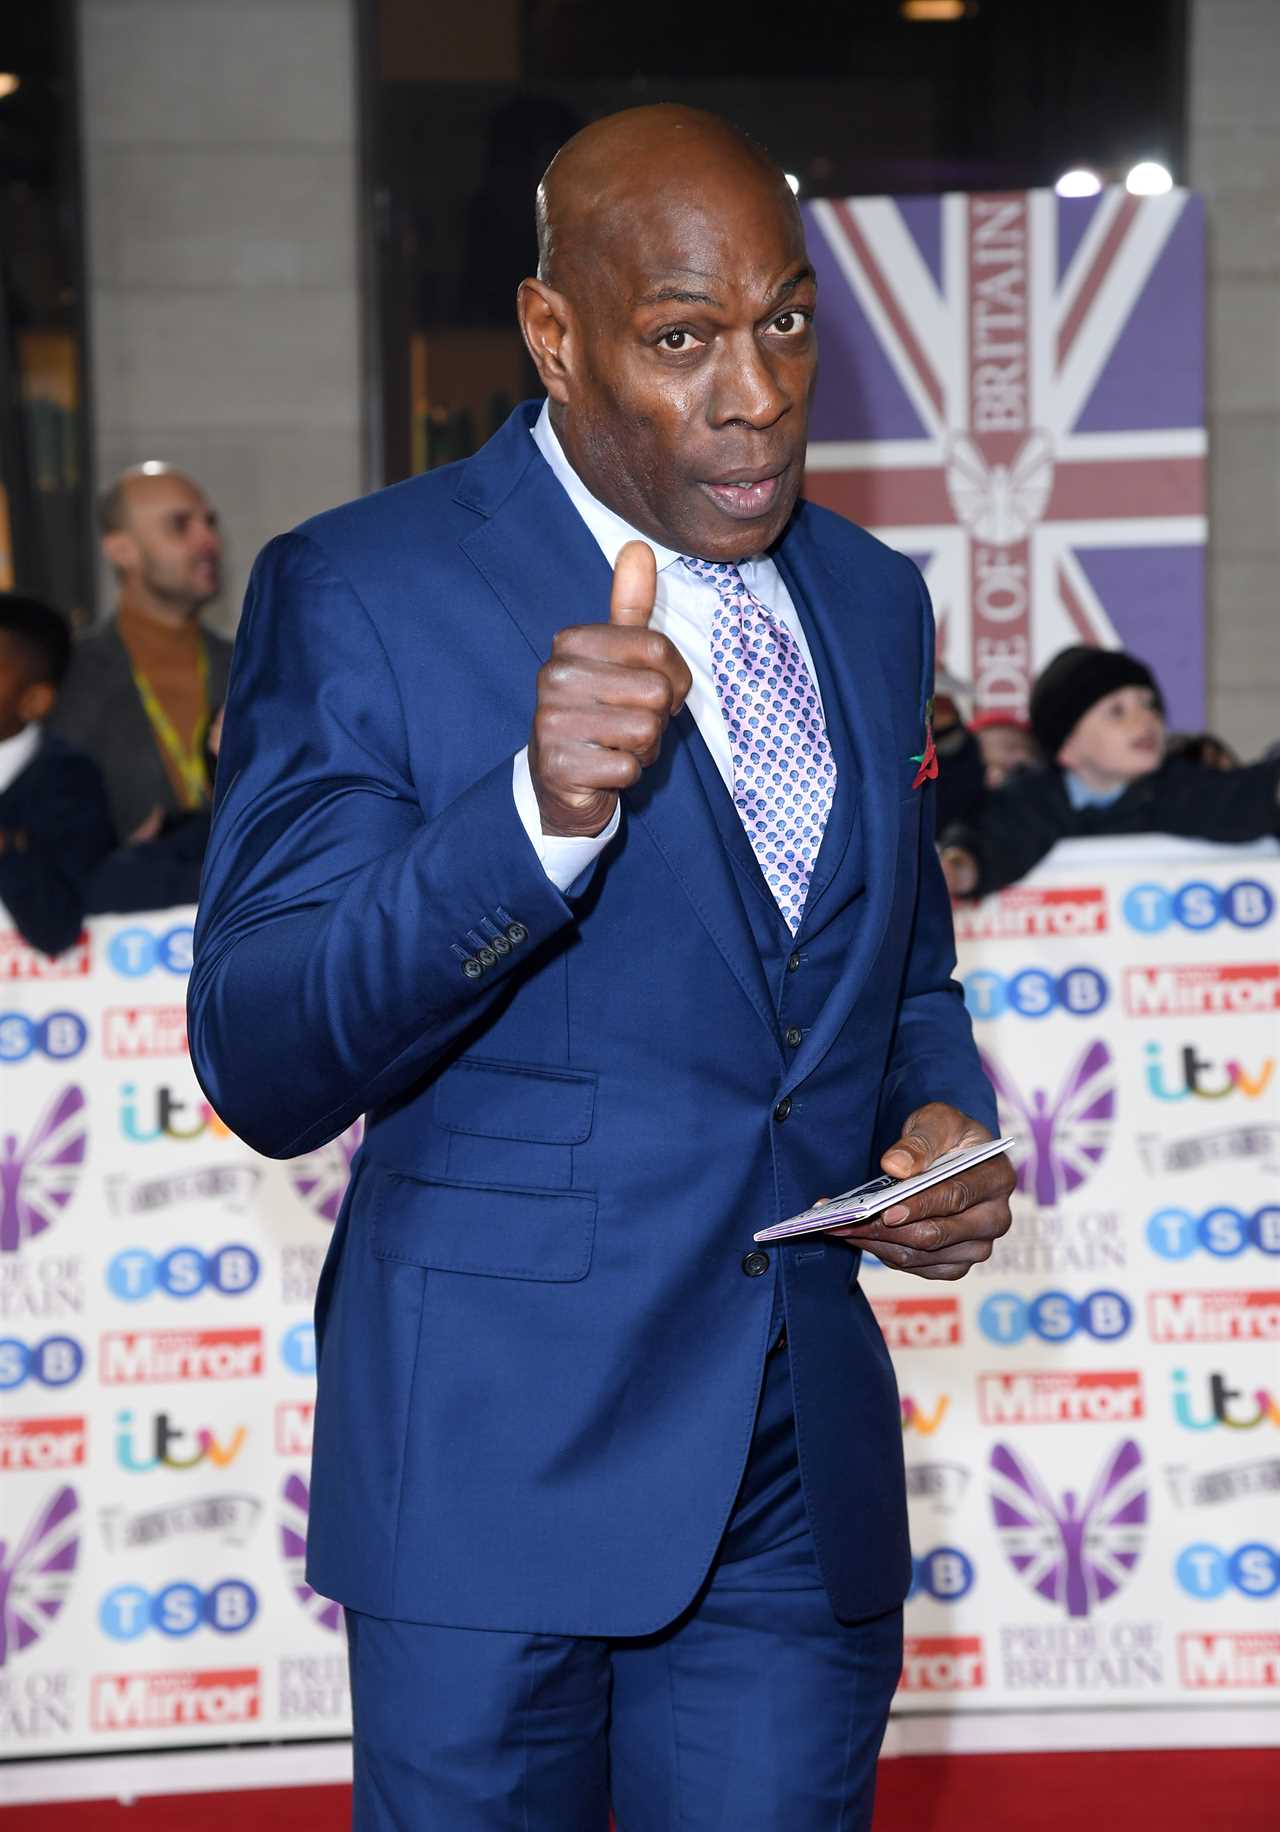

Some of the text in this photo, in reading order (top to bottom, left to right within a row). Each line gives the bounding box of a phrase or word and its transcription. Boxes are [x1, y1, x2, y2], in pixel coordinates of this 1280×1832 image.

[973, 200, 1029, 721] DE OF BRITAIN
[1133, 885, 1268, 925] TSB
[968, 973, 1103, 1012] TSB
[1145, 1042, 1275, 1103] itv
[116, 1249, 251, 1293] TSB
[986, 1299, 1122, 1333] TSB
[109, 1335, 261, 1379] Mirror
[984, 1377, 1140, 1421] Mirror
[117, 1411, 246, 1471] itv
[113, 1590, 250, 1632] TSB
[1001, 1624, 1159, 1652] PRIDE OF
[1003, 1657, 1164, 1689] BRITAIN
[103, 1676, 258, 1728] Mirror
